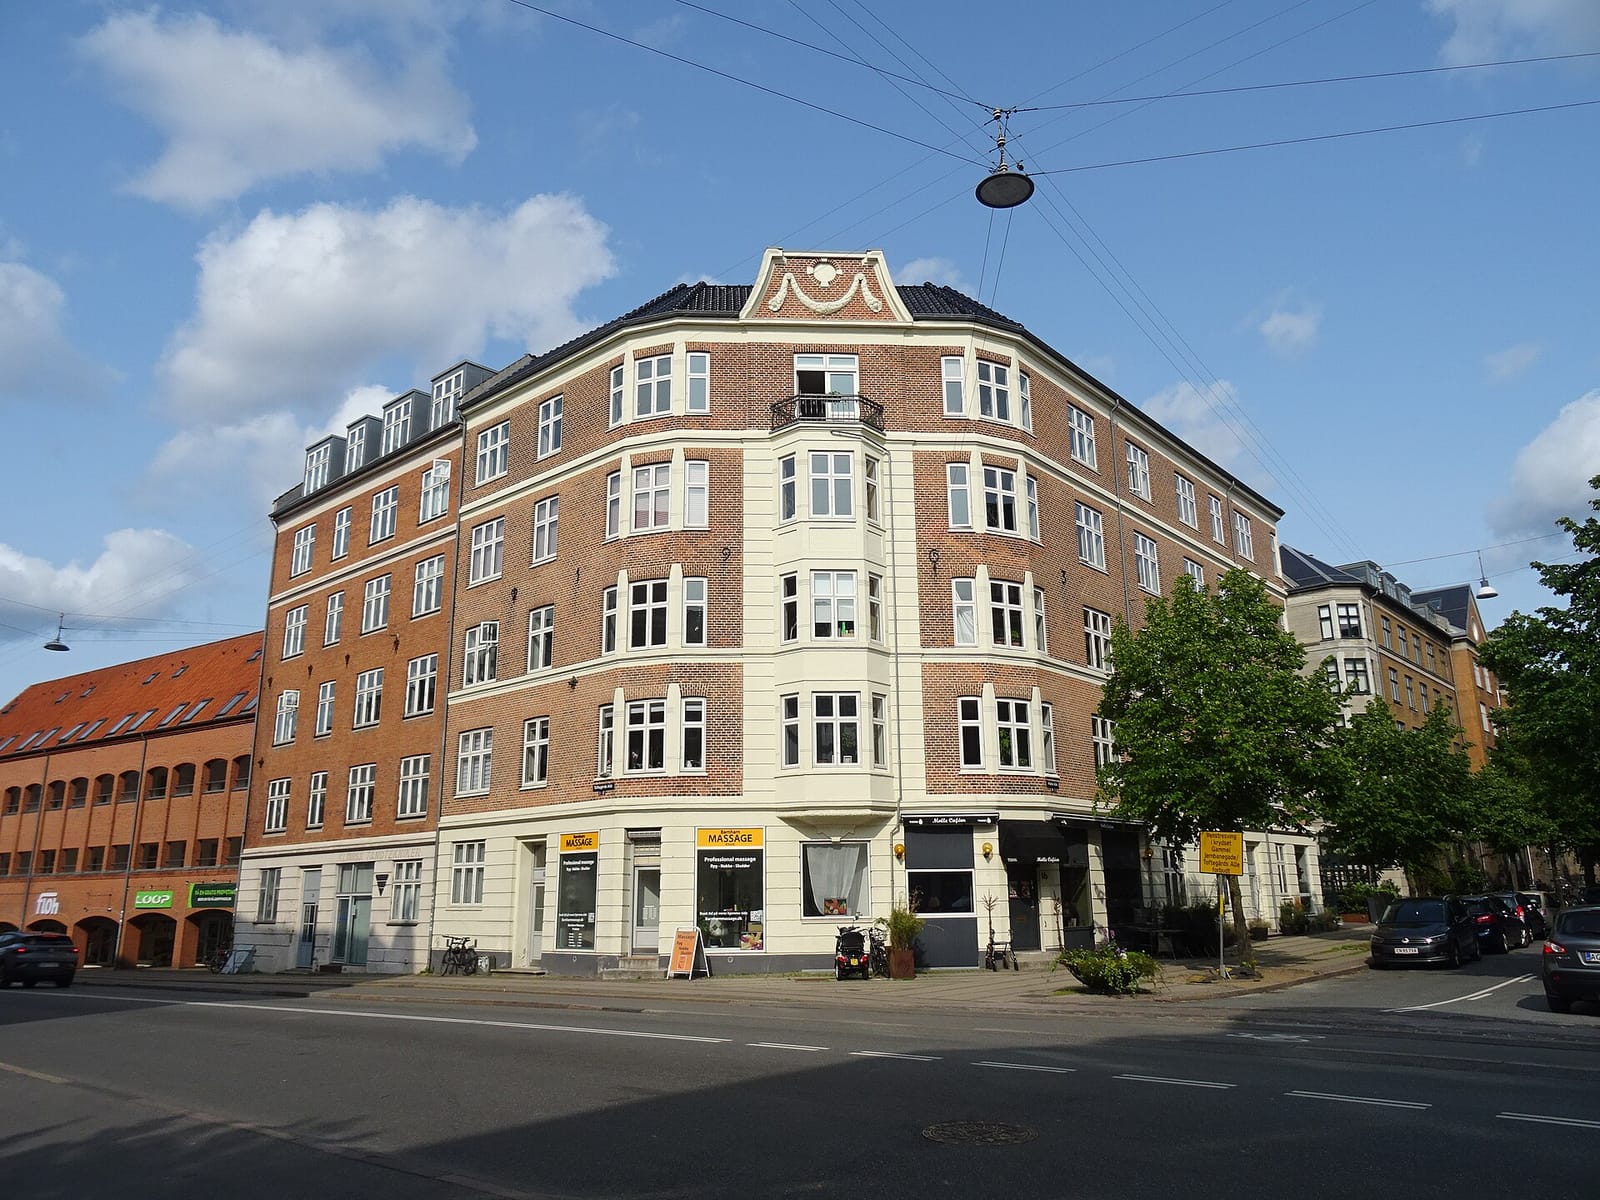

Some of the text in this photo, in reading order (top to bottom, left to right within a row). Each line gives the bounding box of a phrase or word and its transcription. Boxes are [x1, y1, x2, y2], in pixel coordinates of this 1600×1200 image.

[566, 838, 592, 847] MASSAGE
[708, 834, 752, 842] MASSAGE
[135, 895, 170, 904] LOOP
